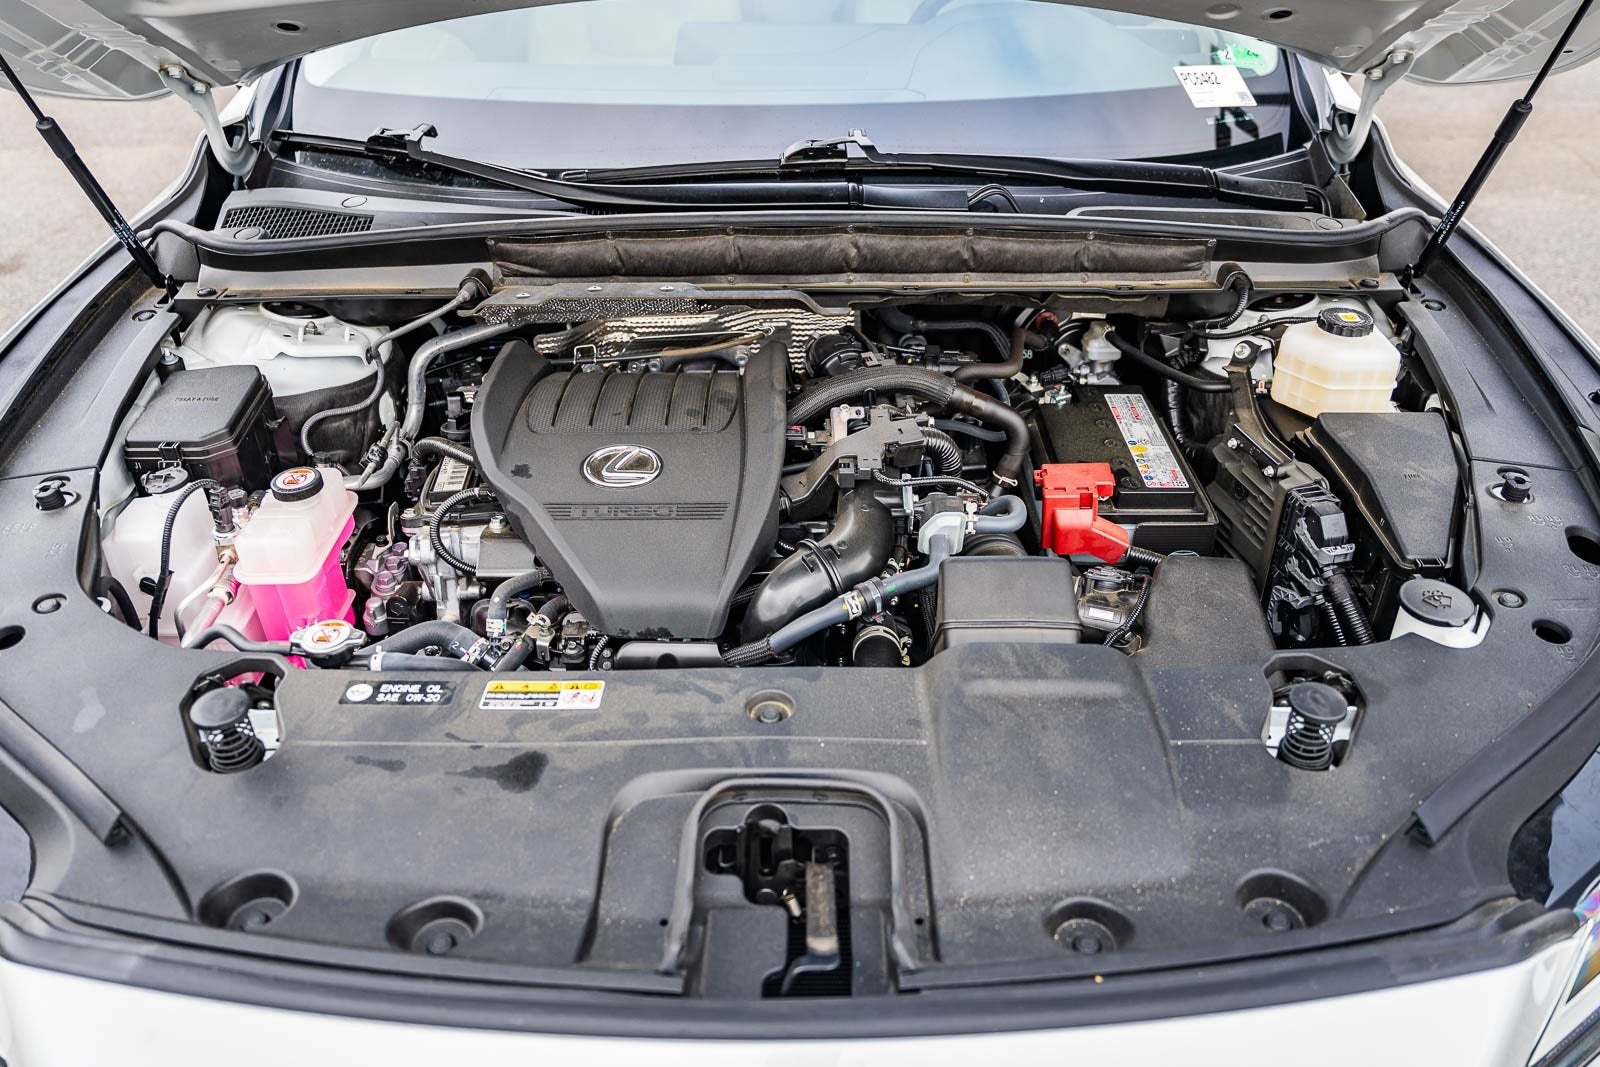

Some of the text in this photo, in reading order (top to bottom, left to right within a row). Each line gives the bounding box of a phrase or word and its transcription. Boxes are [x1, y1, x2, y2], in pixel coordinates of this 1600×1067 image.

[574, 505, 674, 518] TURBO
[379, 684, 443, 693] ENGINE OIL
[376, 693, 441, 702] SAE 0W-20
